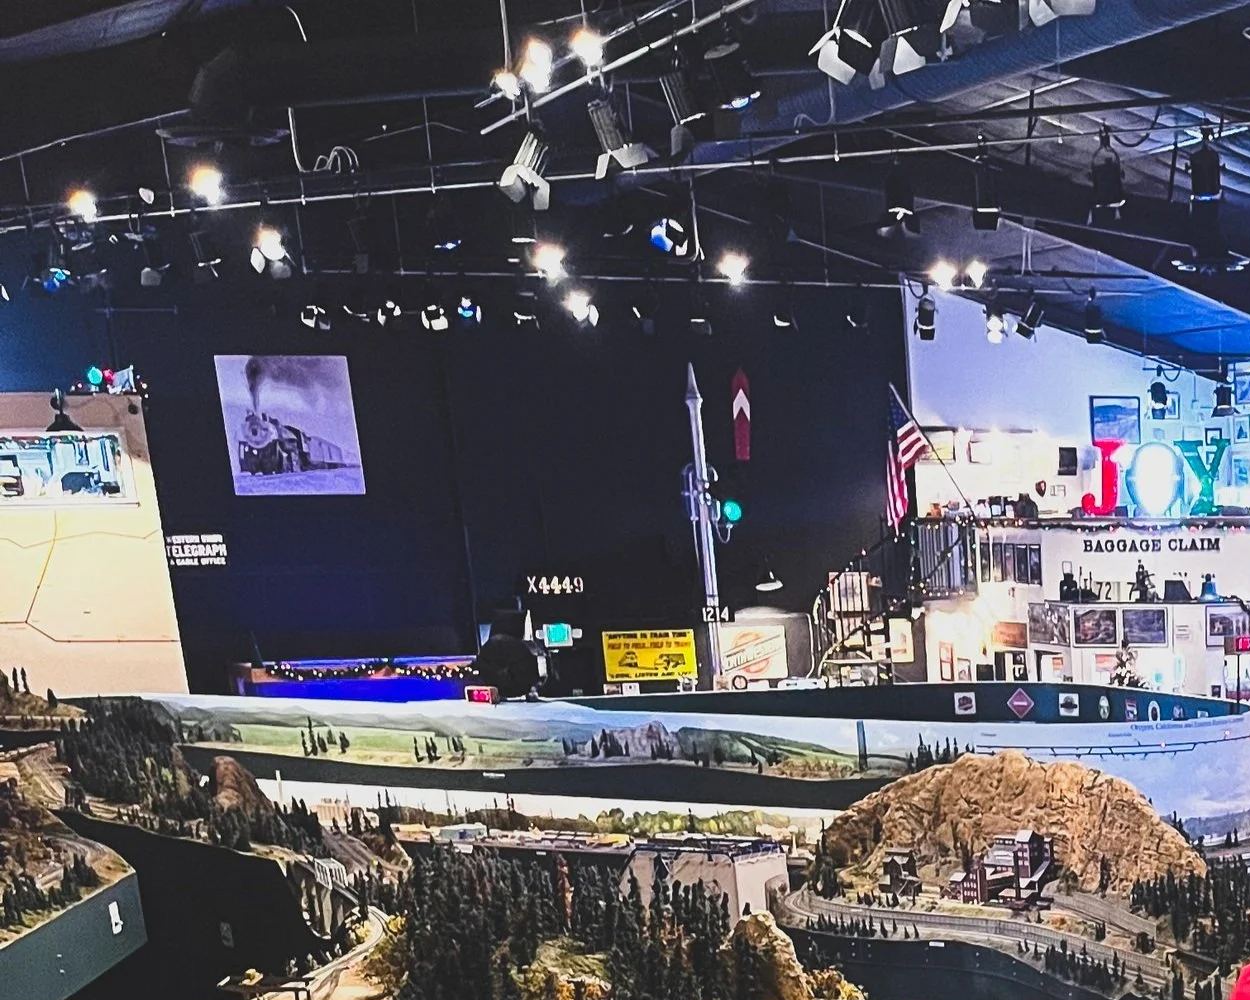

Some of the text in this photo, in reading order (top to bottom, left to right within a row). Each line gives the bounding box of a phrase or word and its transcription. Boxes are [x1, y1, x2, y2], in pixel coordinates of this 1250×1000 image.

[1081, 437, 1231, 516] JOY
[165, 543, 228, 558] TELEGRAPH
[1083, 537, 1221, 552] BAGGAGE CLAIM
[526, 575, 584, 595] X4449
[702, 605, 729, 622] 1214
